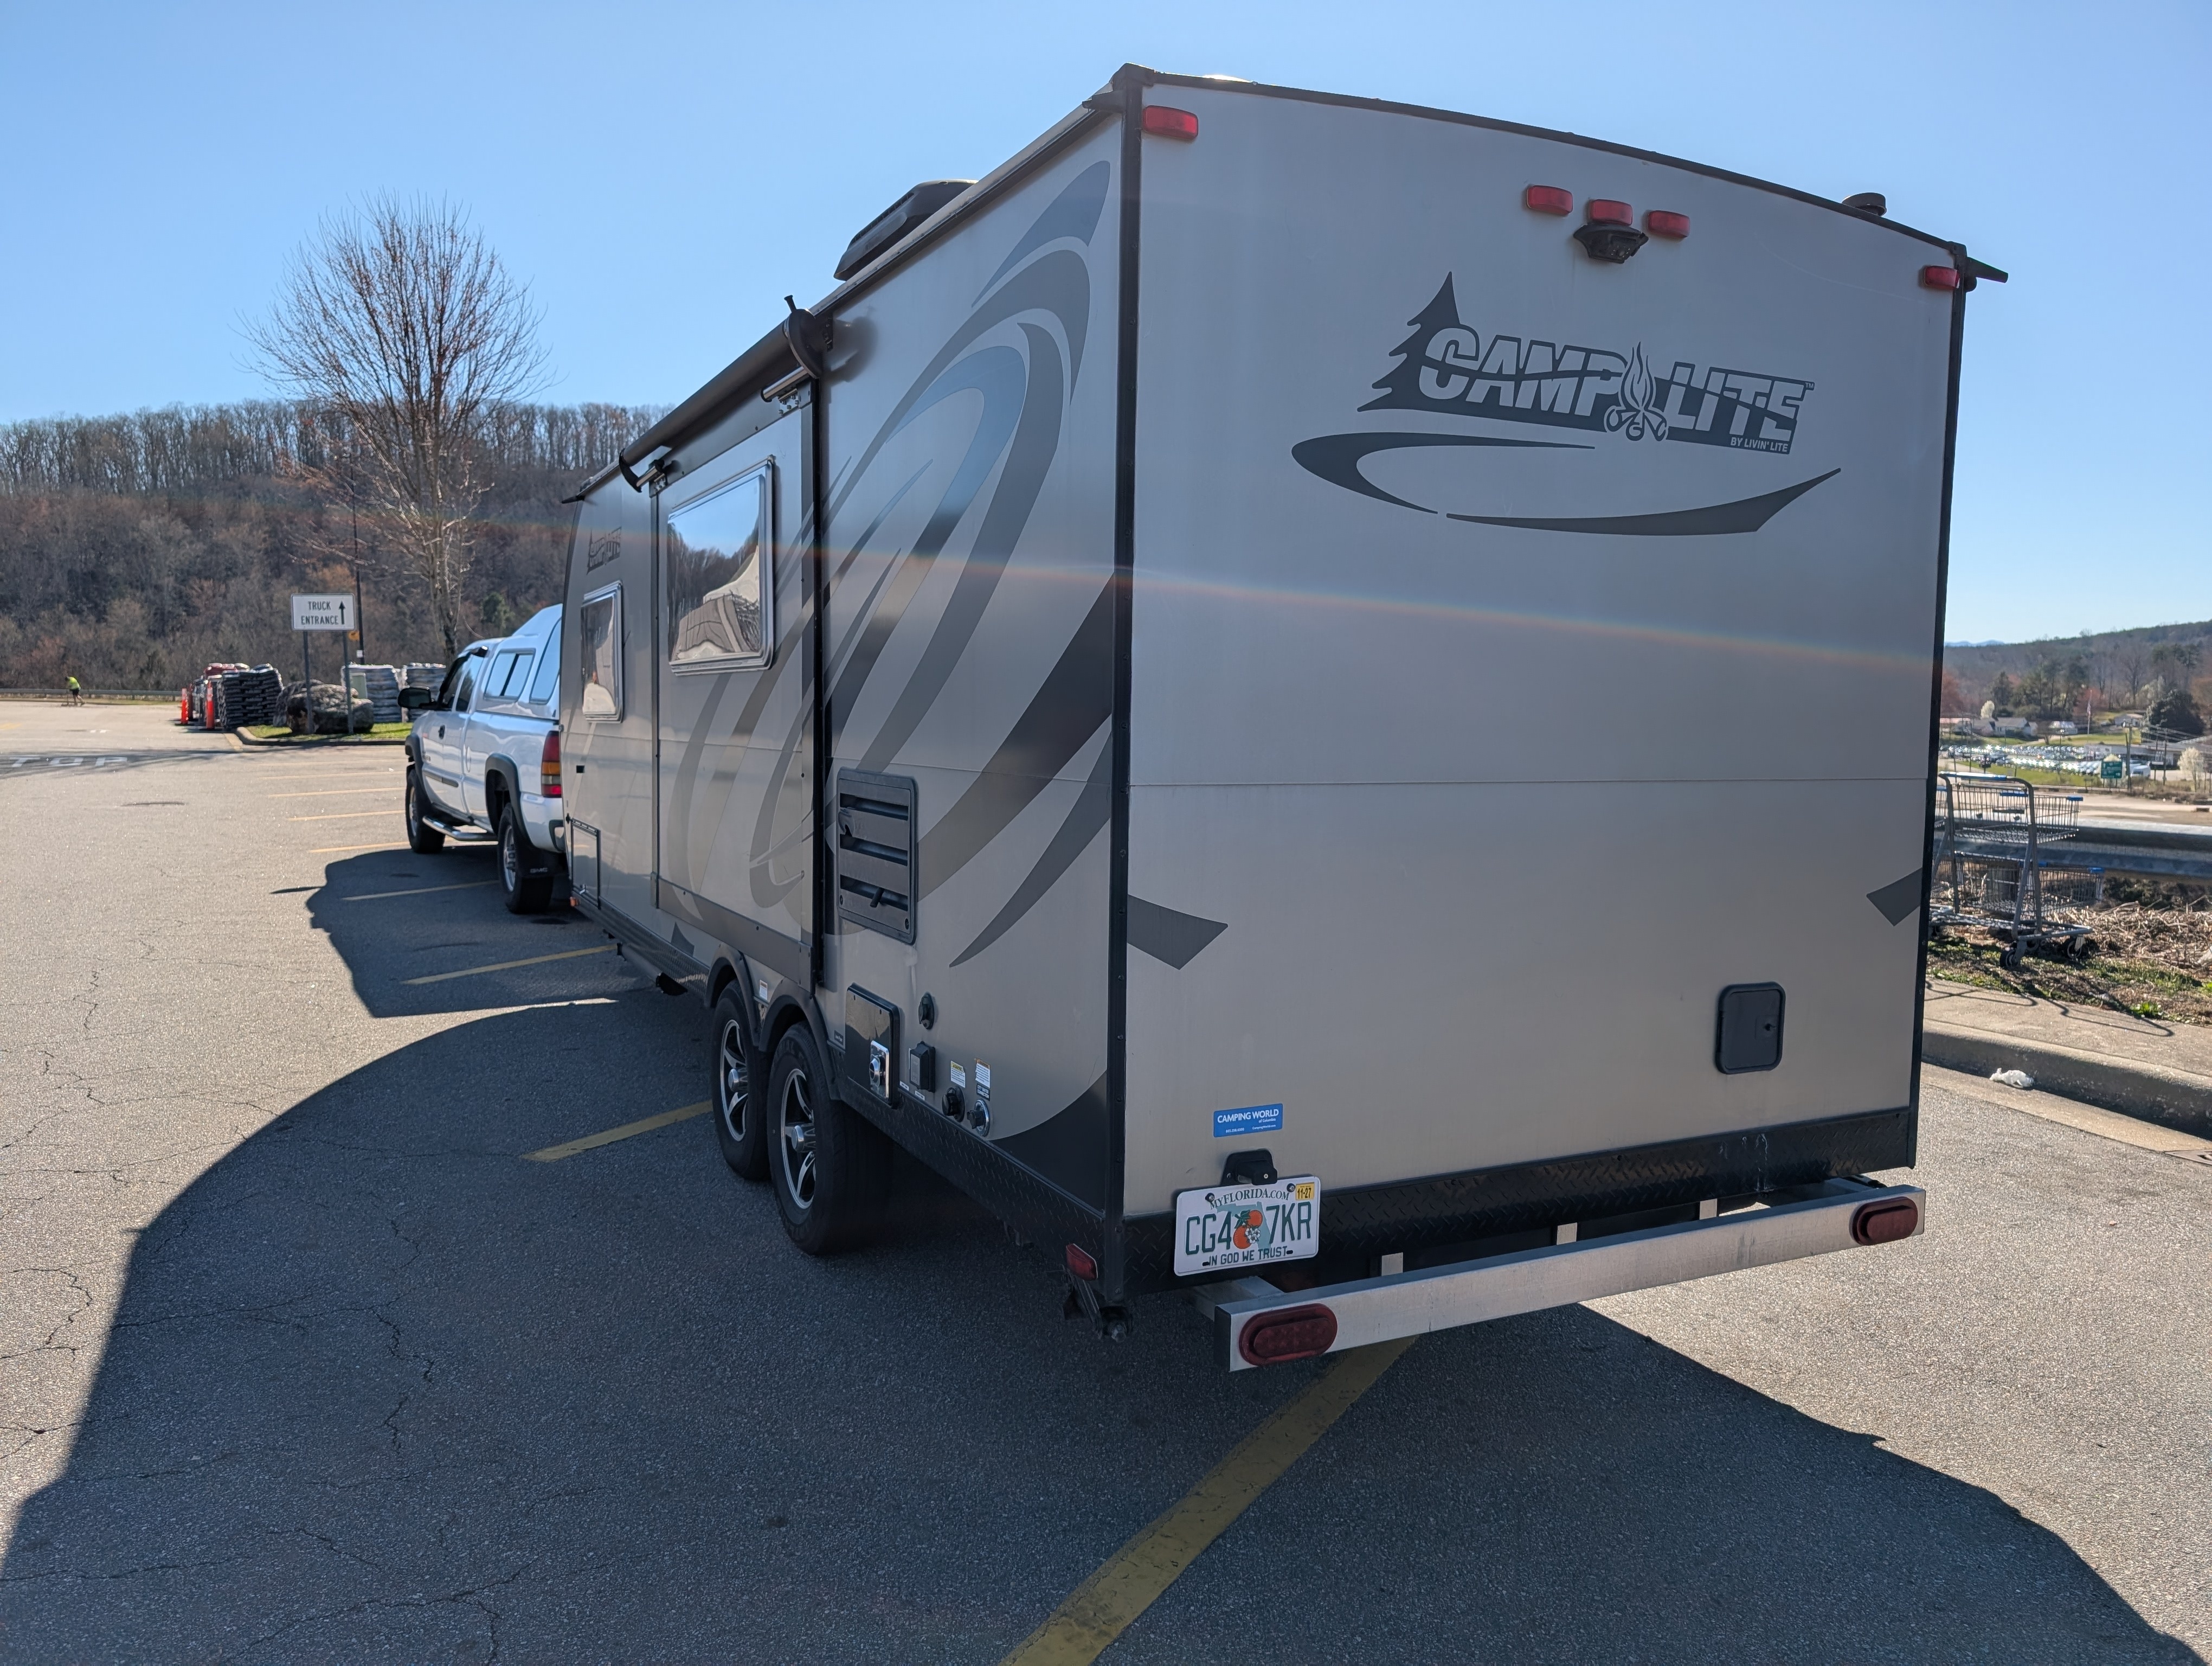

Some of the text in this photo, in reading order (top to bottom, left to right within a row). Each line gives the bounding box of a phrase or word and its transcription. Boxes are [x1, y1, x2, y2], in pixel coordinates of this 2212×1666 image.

[1417, 325, 1628, 418] CAMP
[1662, 363, 1805, 442] LITE
[1730, 437, 1789, 452] BY LIVIN' LITE
[308, 601, 331, 611] TRUCK
[301, 615, 339, 625] ENTRANCE
[1217, 1108, 1279, 1123] CAMPING WORLD
[1210, 1188, 1290, 1210] MYFLORIDA.COM
[1209, 1246, 1288, 1266] IN GOD WE TRUST
